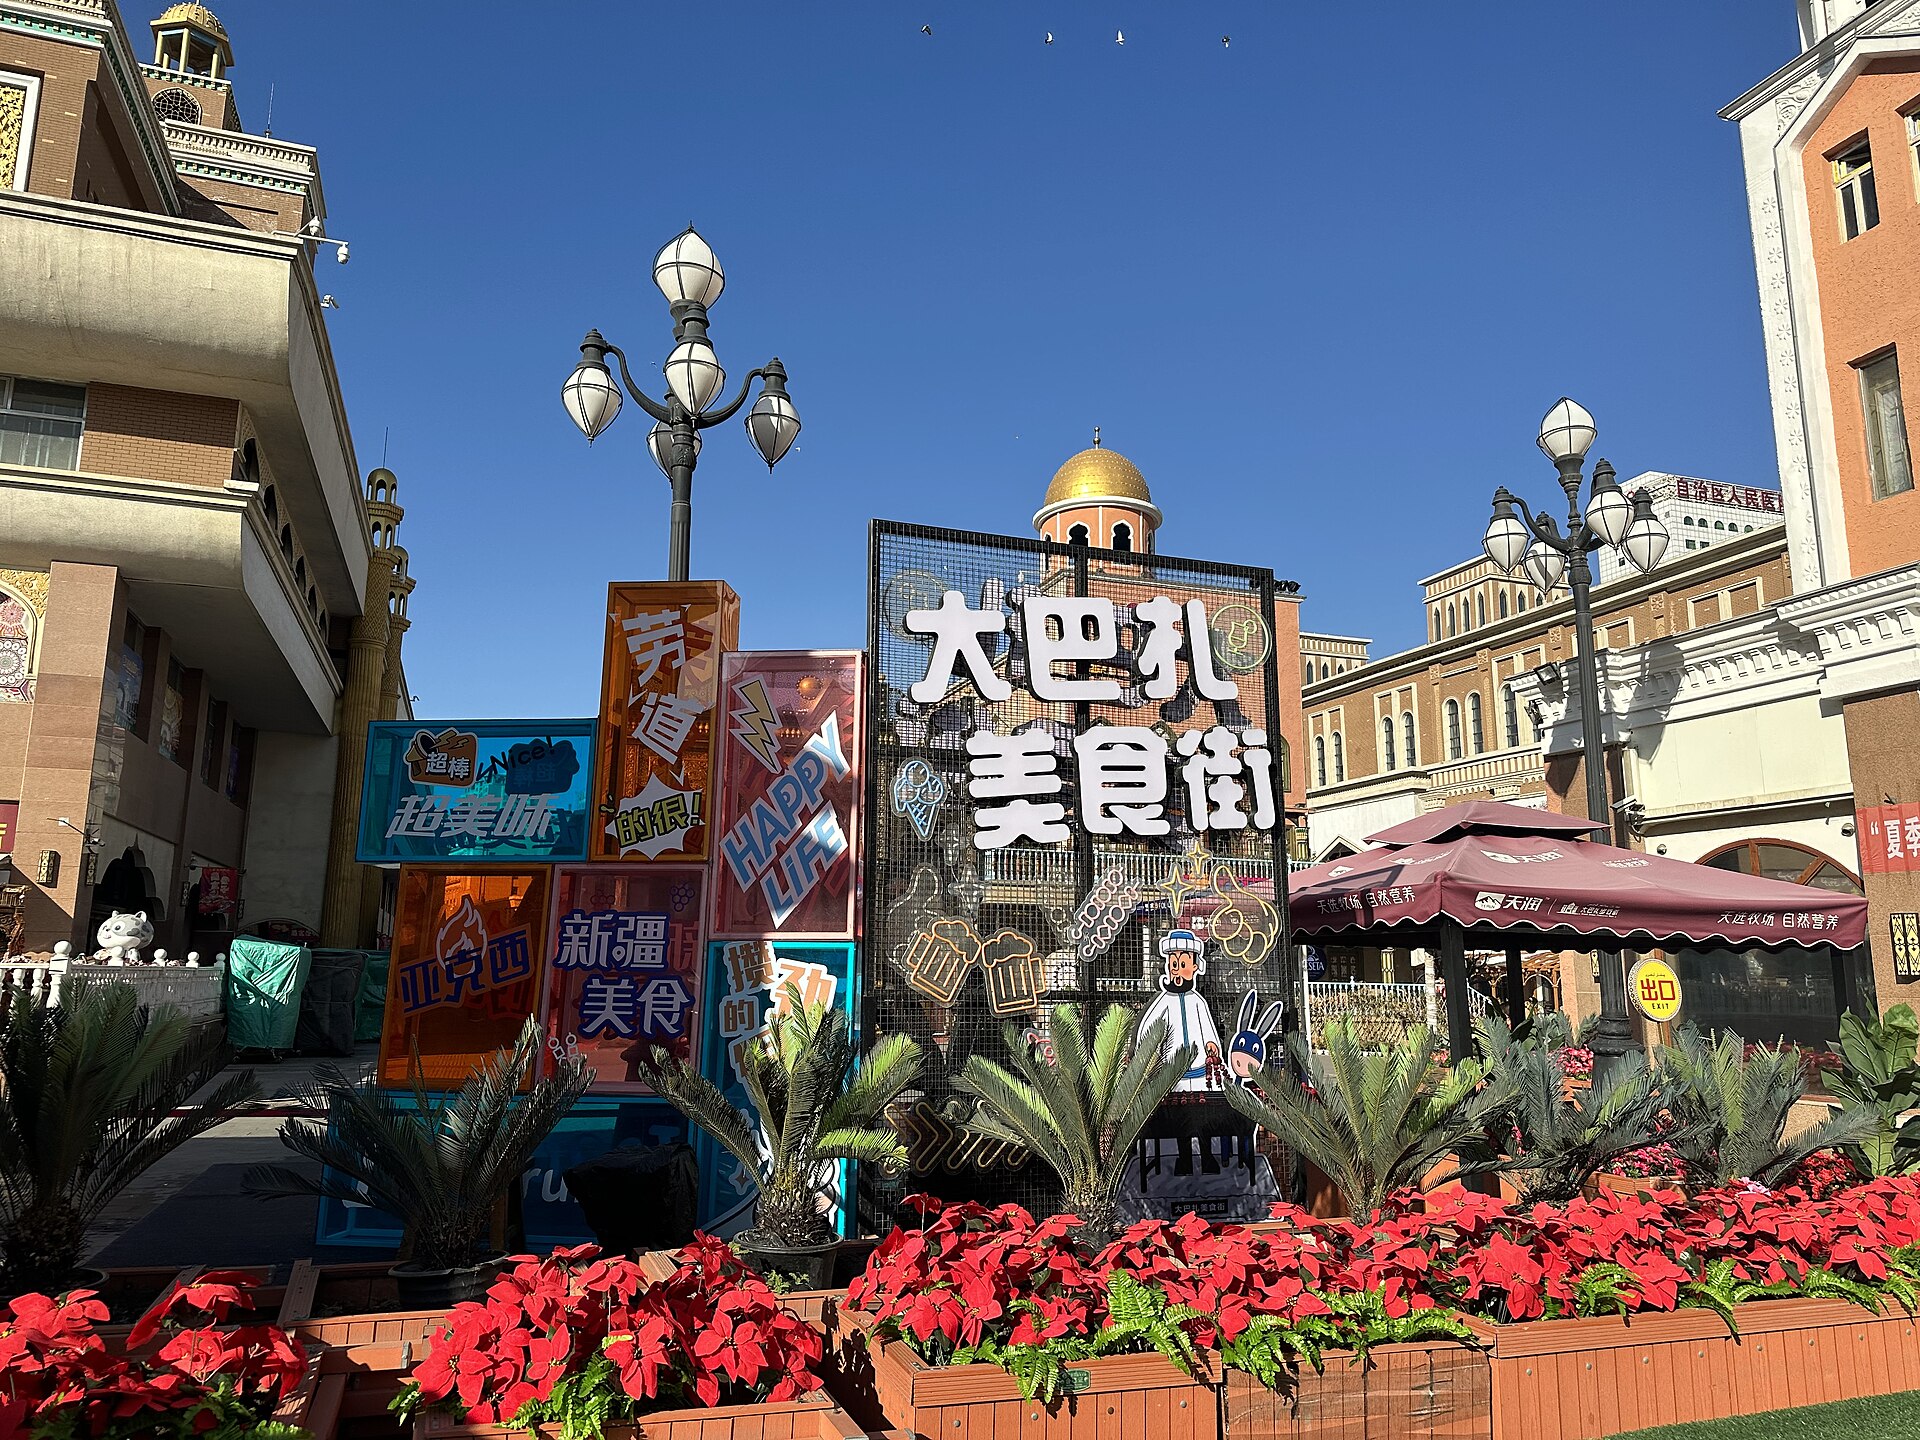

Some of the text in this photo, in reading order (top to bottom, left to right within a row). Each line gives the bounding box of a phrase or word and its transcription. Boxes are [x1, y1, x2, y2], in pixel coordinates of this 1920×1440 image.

[1677, 477, 1784, 512] 自治区人民医
[905, 591, 1238, 702] 大巴扎
[425, 752, 471, 779] 超棒
[722, 712, 850, 891] HAPPY
[966, 726, 1276, 850] 美食街
[386, 793, 560, 838] 超美味
[1317, 886, 1416, 914] 天选牧场 自然营养
[1503, 895, 1543, 911] 天润
[1717, 911, 1839, 931] 天选牧场 自然营养
[557, 913, 668, 969] 新疆
[402, 935, 532, 1012] 亚克西
[1306, 961, 1325, 971] SETA
[1640, 978, 1676, 1001] 出口
[582, 978, 691, 1036] 美食
[1651, 1002, 1669, 1010] EXIT
[1175, 1203, 1225, 1213] 大巴扎美食街
